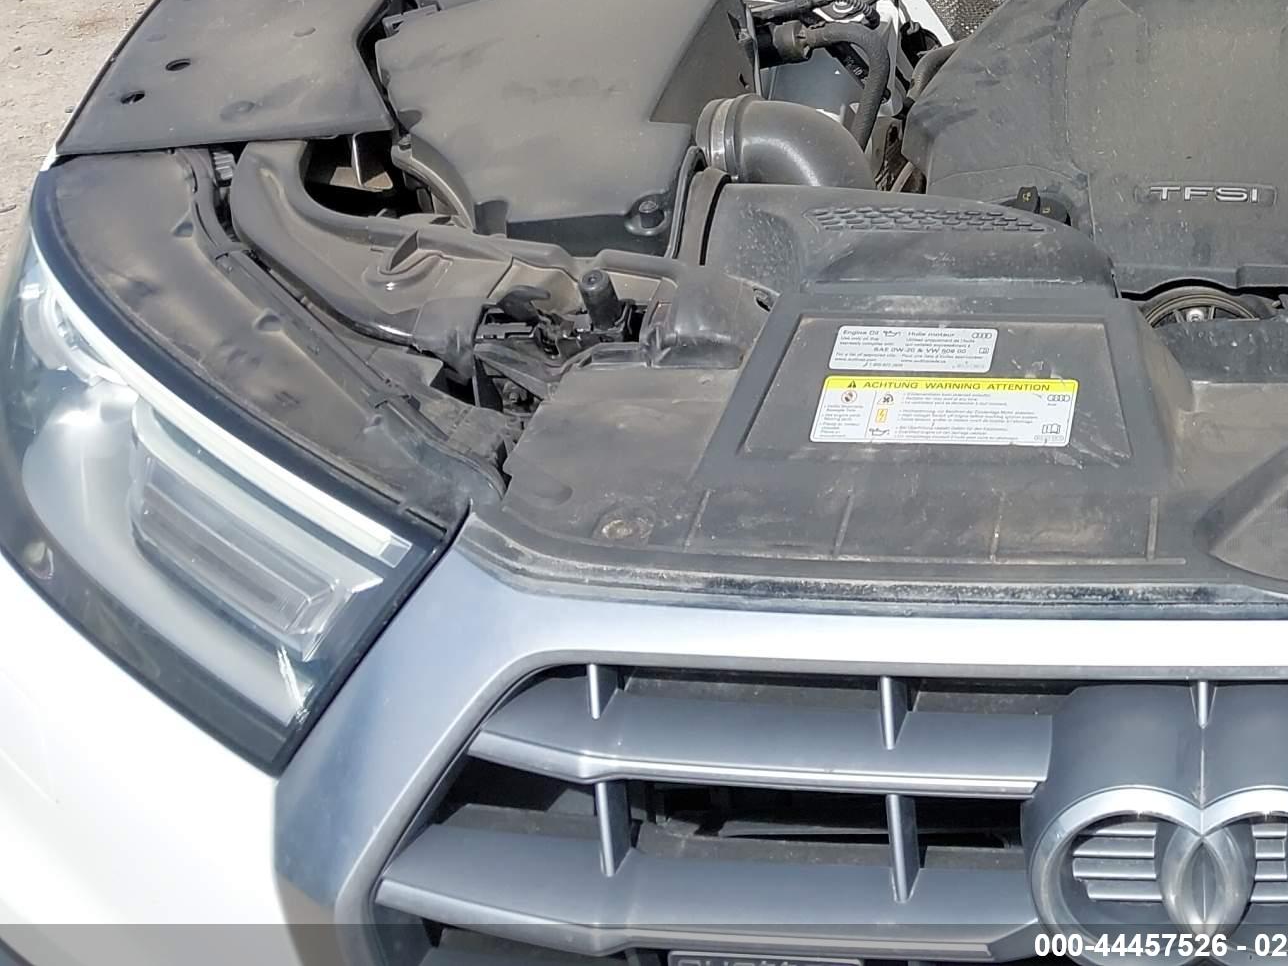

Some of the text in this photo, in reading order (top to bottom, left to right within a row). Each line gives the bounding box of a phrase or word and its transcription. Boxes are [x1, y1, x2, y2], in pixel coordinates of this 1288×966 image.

[1149, 186, 1259, 203] TFSI
[863, 381, 1050, 391] ACHTUNG WARNING ATTENTION
